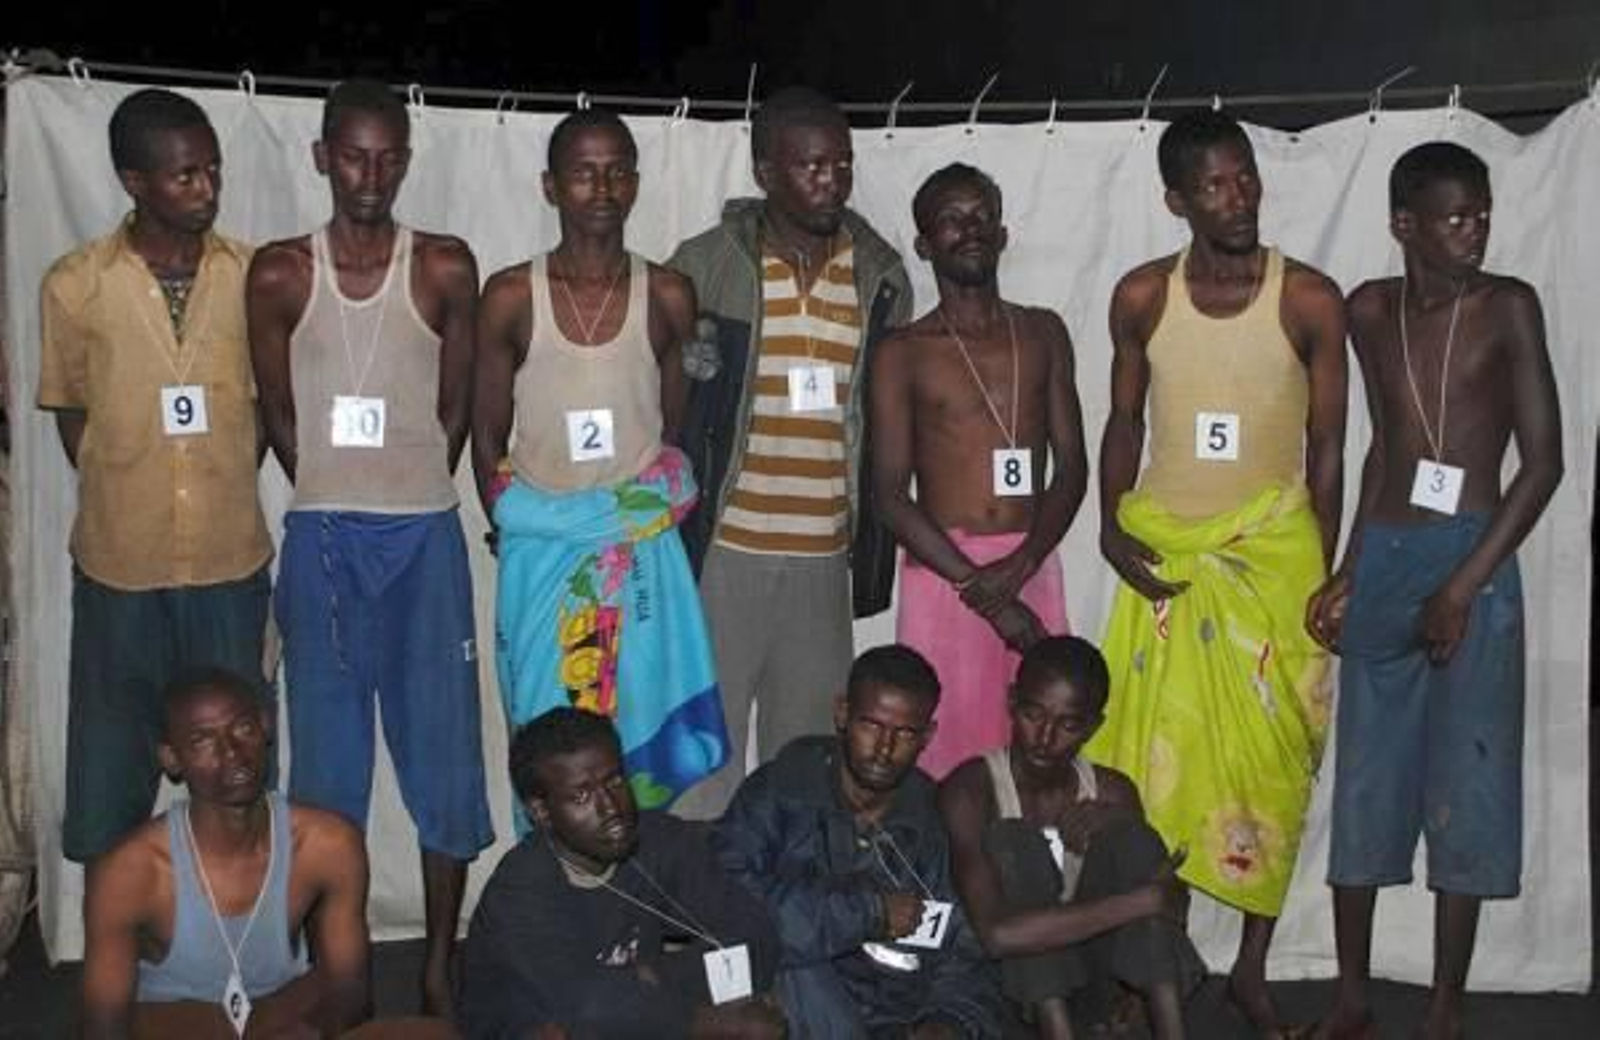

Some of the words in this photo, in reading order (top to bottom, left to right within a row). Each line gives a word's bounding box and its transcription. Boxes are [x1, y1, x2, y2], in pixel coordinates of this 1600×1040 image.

[805, 372, 818, 396] 4
[173, 395, 193, 425] 9
[581, 421, 602, 451] 2
[1208, 423, 1228, 451] 5
[1004, 458, 1021, 487] 8
[1429, 468, 1446, 493] 3
